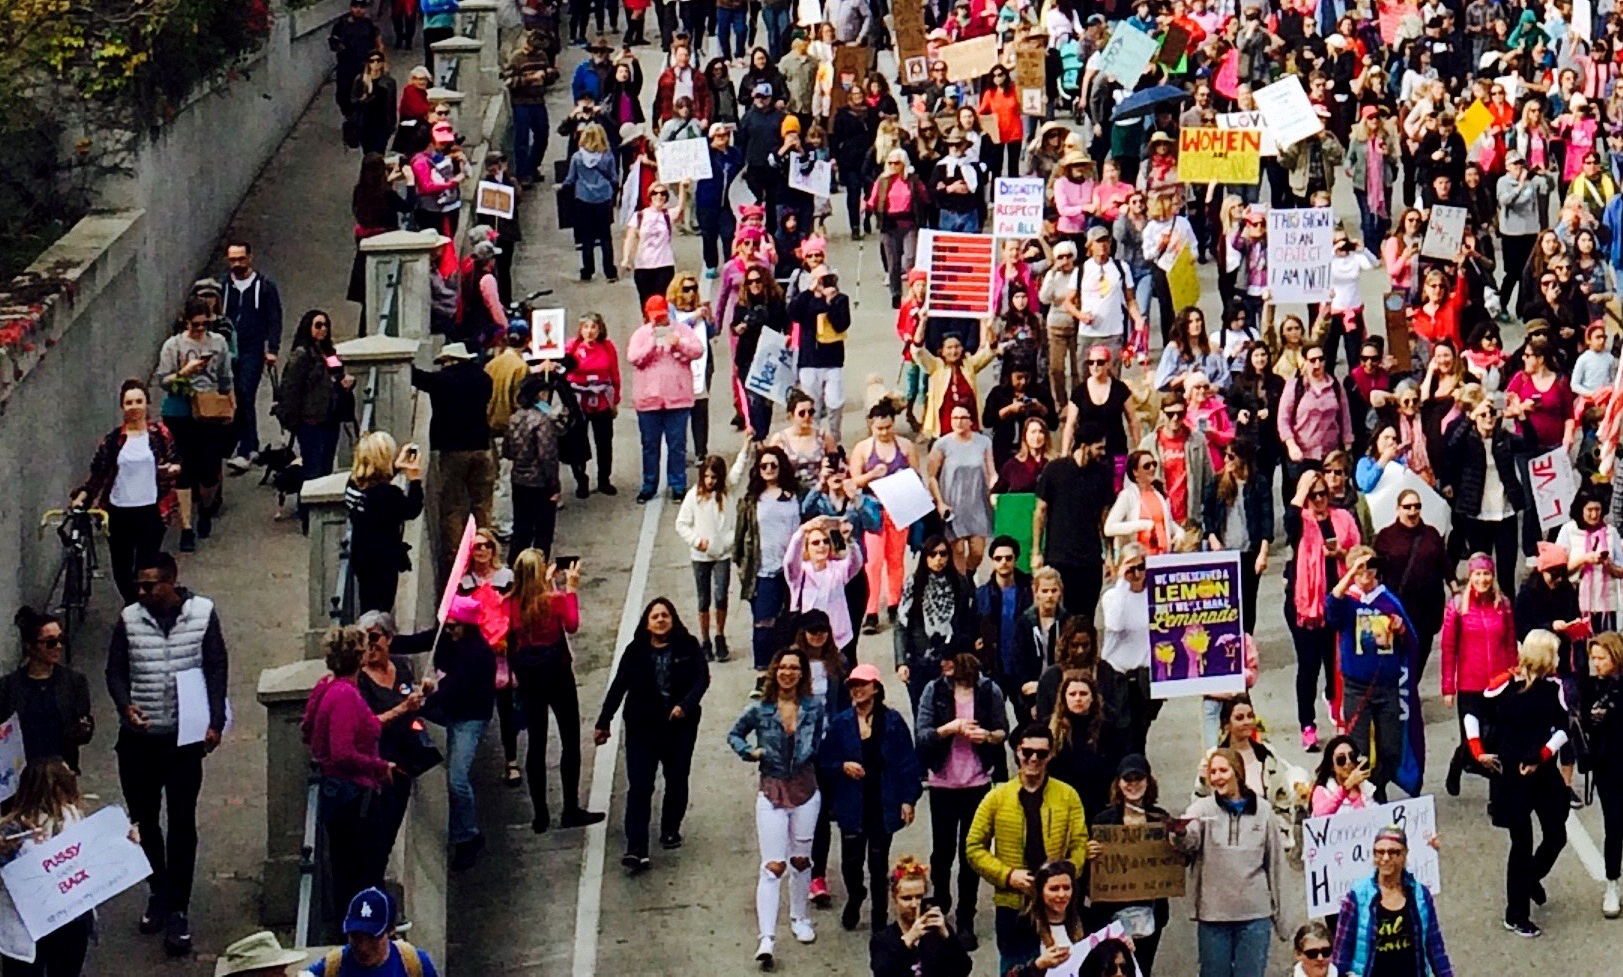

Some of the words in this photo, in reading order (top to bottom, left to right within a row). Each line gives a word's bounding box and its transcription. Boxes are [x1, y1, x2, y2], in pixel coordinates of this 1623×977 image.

[1182, 130, 1261, 152] WOMEN
[1271, 211, 1299, 229] THIS
[1285, 232, 1297, 245] IS
[1298, 233, 1314, 246] AN
[1281, 268, 1300, 285] AM
[750, 352, 777, 392] Hear
[1149, 608, 1238, 632] Lemonade
[42, 842, 82, 873] PUSSY
[58, 870, 91, 895] BACK
